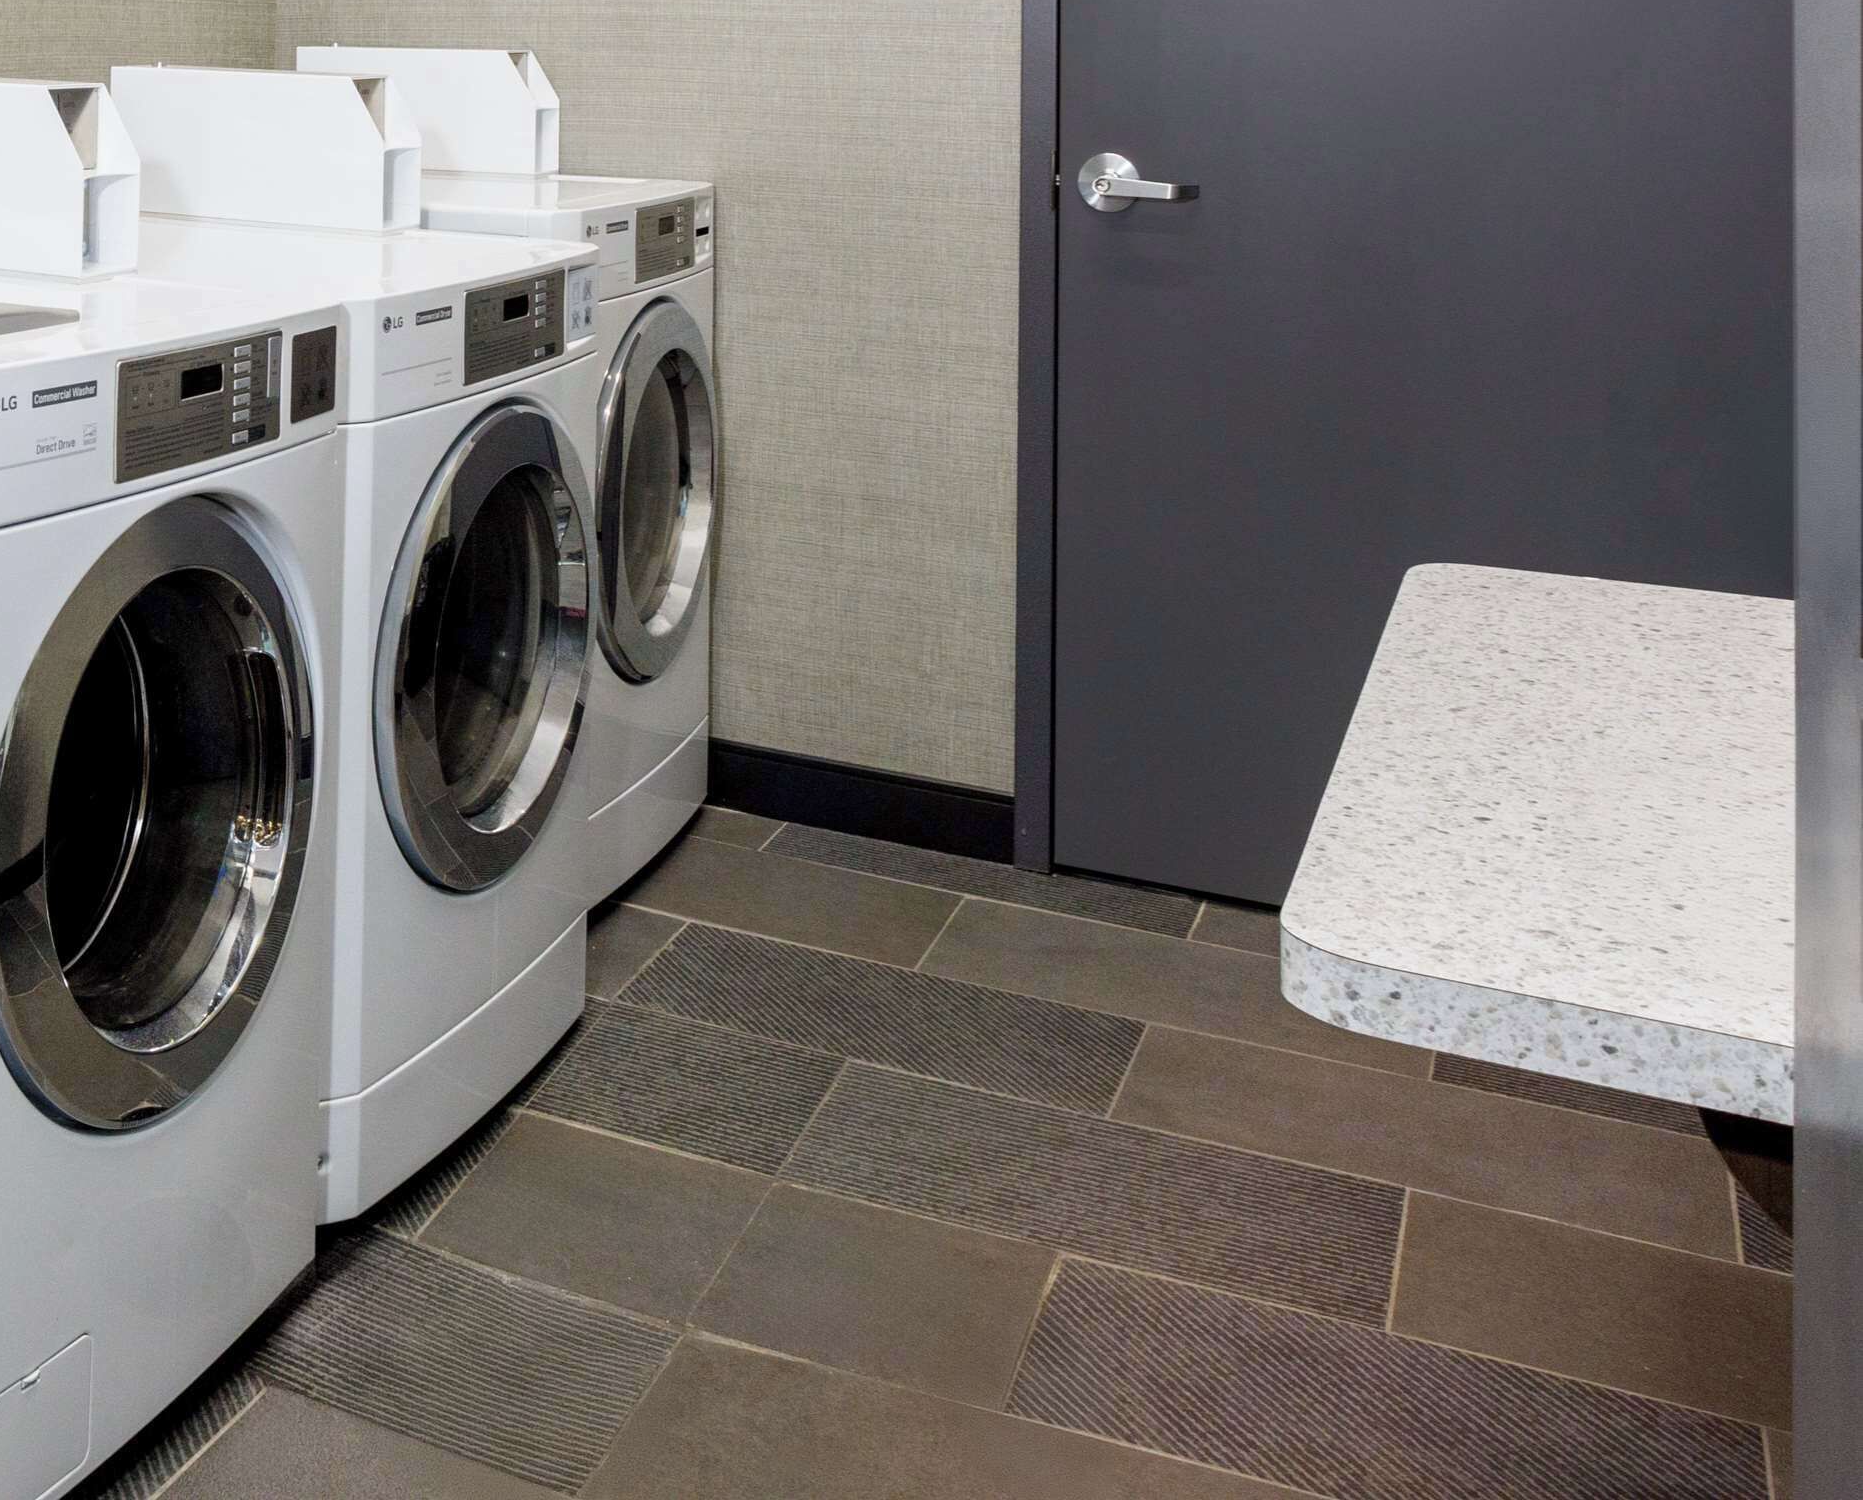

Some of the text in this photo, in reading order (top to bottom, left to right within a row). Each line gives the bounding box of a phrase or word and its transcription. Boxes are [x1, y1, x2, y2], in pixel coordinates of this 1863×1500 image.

[393, 316, 403, 329] LG
[1, 396, 18, 411] LG
[34, 389, 72, 405] Commercial
[36, 440, 57, 455] Direct
[58, 438, 76, 452] Drive
